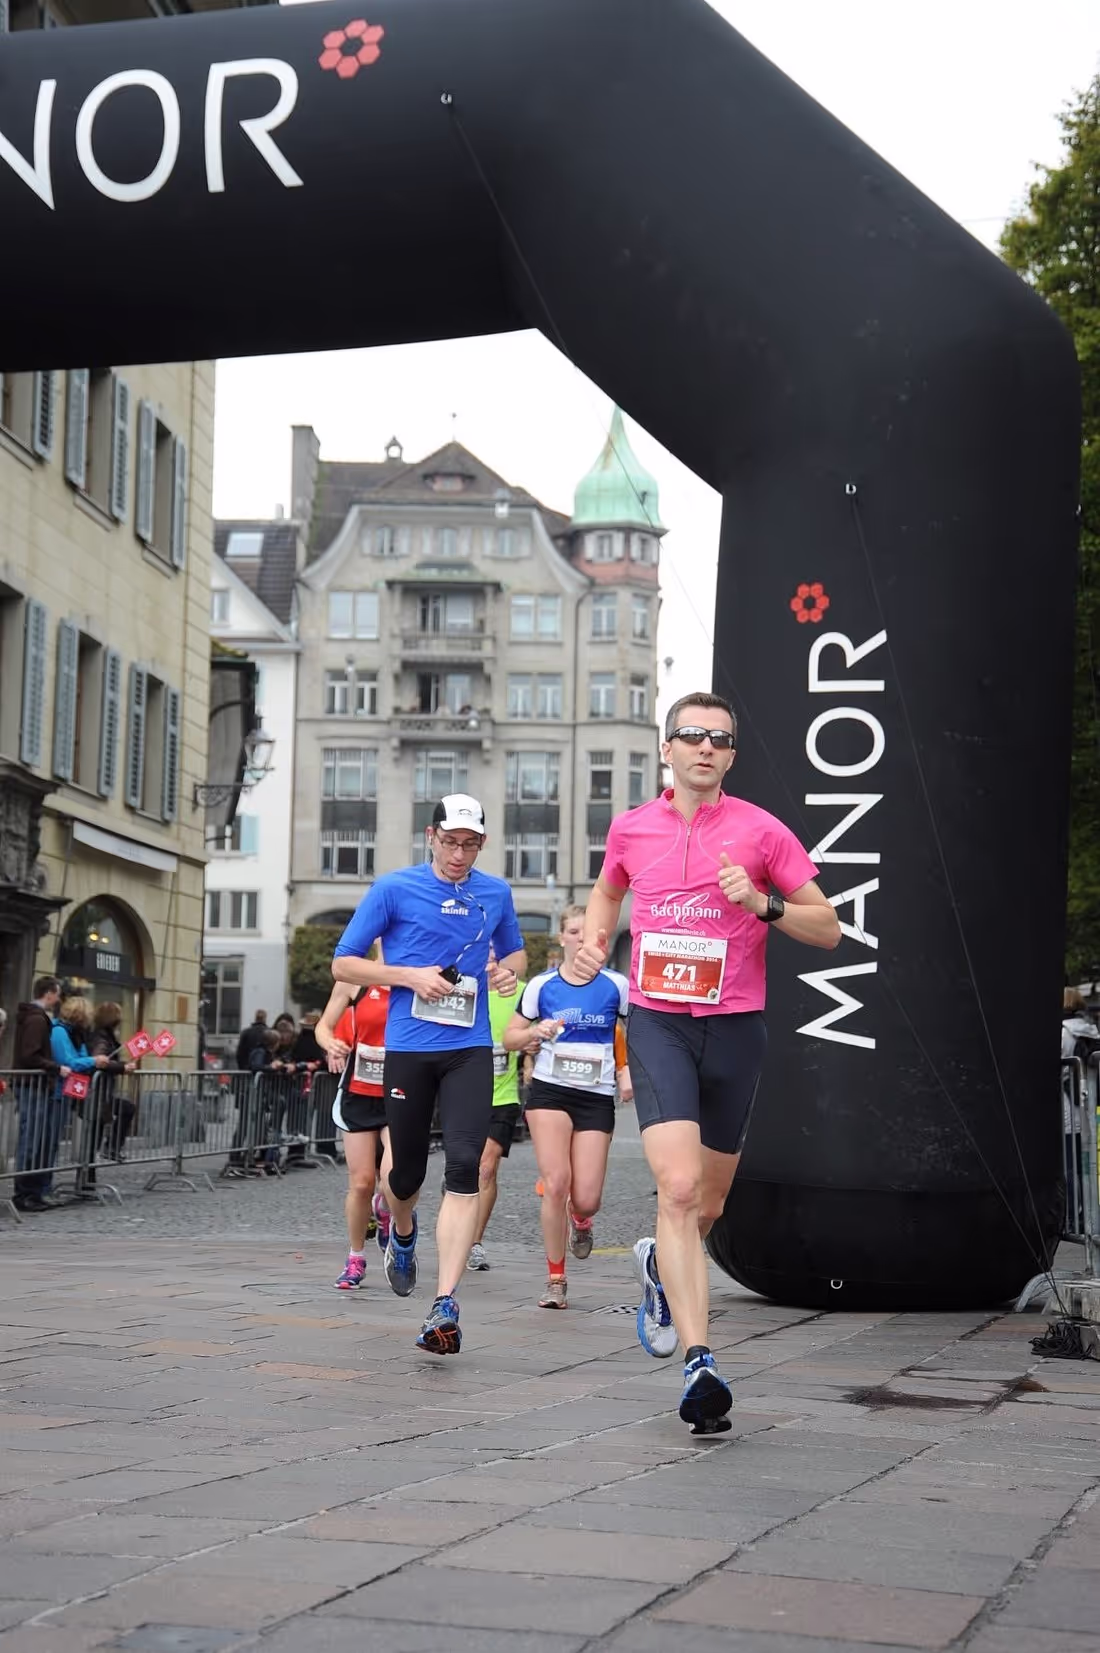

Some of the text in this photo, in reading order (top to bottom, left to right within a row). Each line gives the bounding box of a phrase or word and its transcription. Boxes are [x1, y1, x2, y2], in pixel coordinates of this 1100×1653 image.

[795, 628, 888, 1050] MANOR
[440, 906, 469, 917] skinfit
[650, 903, 721, 919] Bachmann
[657, 939, 707, 953] MANOR
[662, 963, 696, 983] 471
[662, 982, 696, 992] MATTHIAS
[578, 1013, 605, 1025] LSVB
[561, 1060, 592, 1074] 3599
